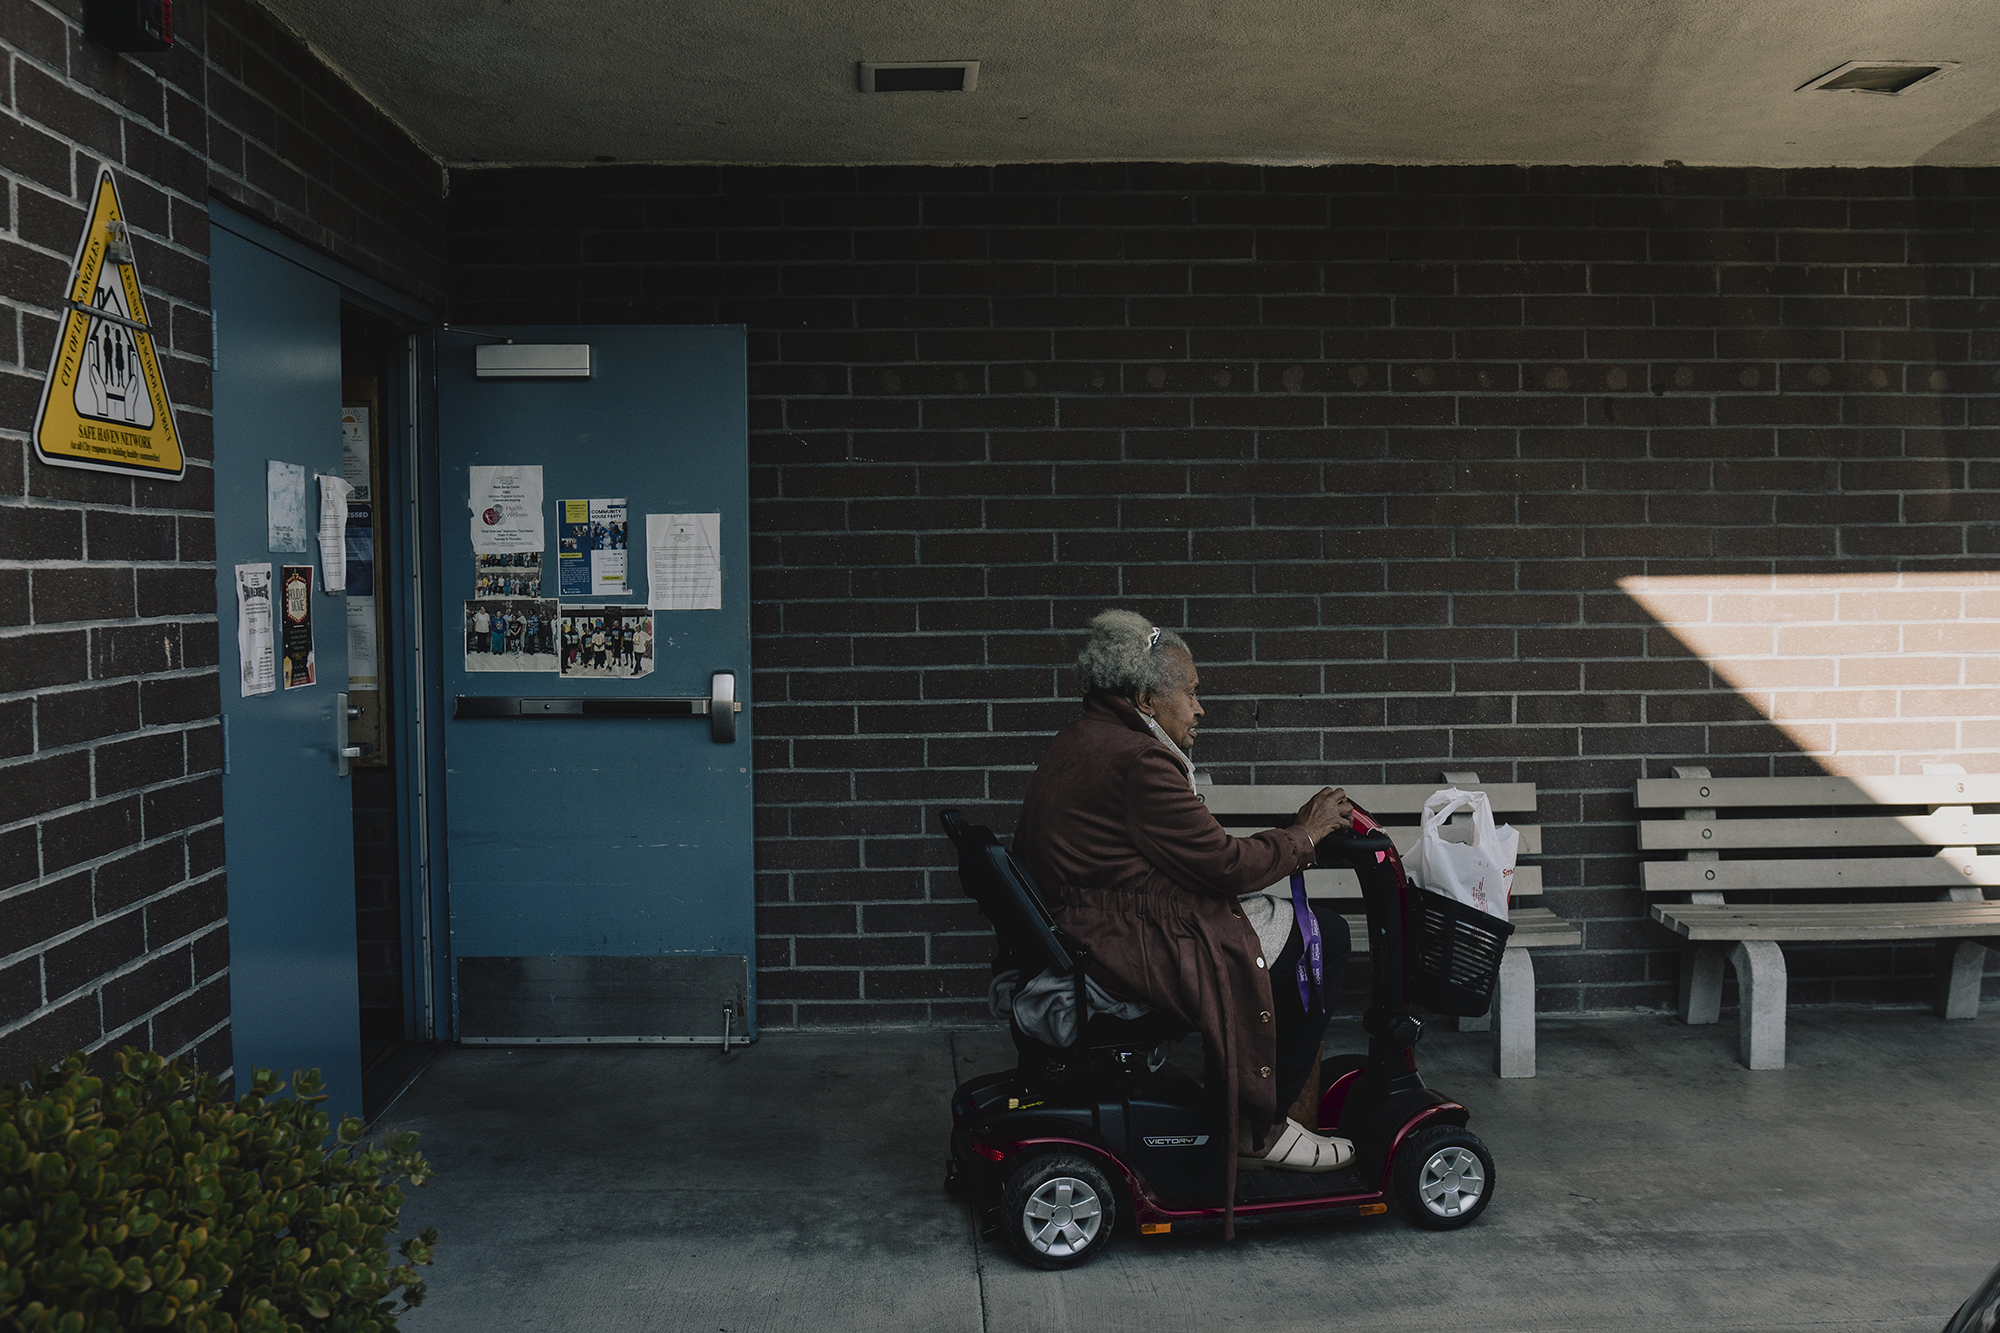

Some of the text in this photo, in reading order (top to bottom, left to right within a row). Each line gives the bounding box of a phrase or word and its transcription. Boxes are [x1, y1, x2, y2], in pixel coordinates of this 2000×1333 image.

[61, 350, 75, 386] CITY
[68, 331, 81, 353] OF
[79, 237, 101, 297] ANGELES
[141, 348, 157, 393] SCHOOL
[155, 393, 171, 441] DISTRICT
[78, 424, 152, 449] SAFE HAVEN NETWORK
[82, 442, 91, 454] City
[288, 588, 306, 600] HOLIDAY
[291, 600, 306, 612] MOVIE
